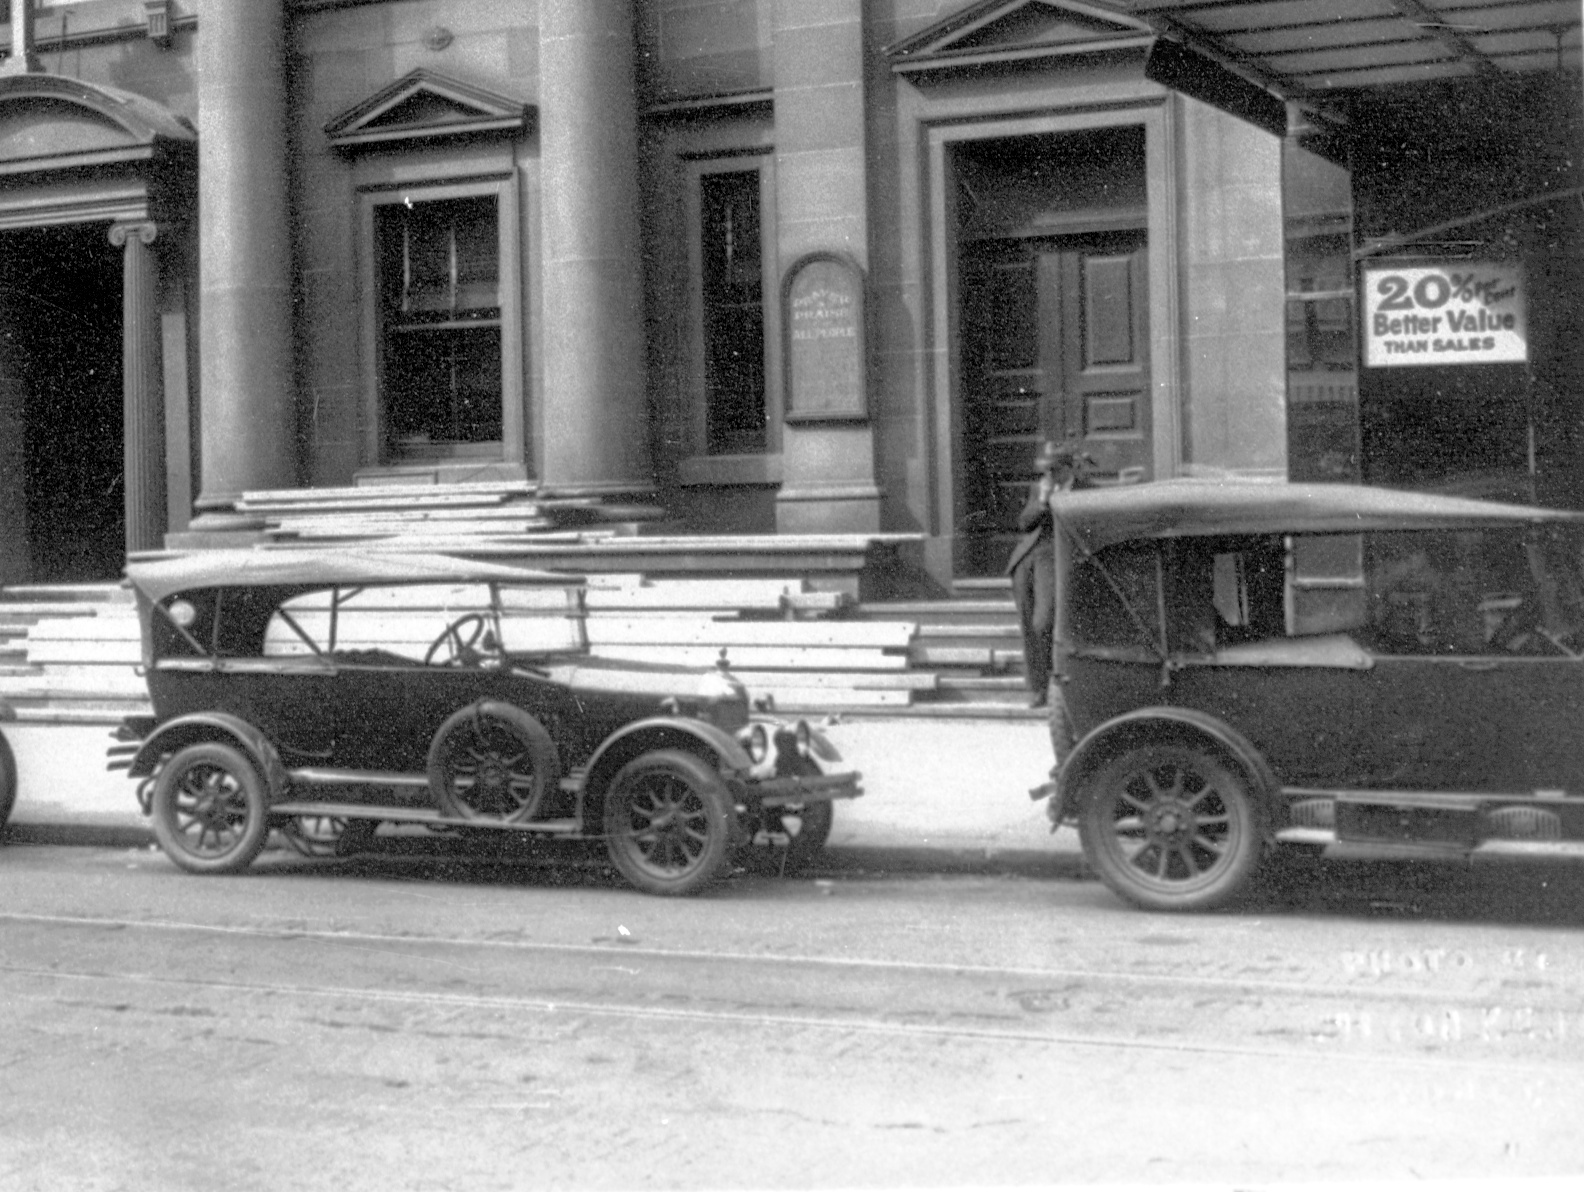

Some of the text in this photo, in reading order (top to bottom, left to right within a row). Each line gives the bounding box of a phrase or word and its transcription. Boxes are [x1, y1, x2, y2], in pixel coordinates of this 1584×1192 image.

[1377, 273, 1474, 311] 20%
[1373, 308, 1515, 336] Better Value
[1384, 336, 1495, 354] THAN SALES
